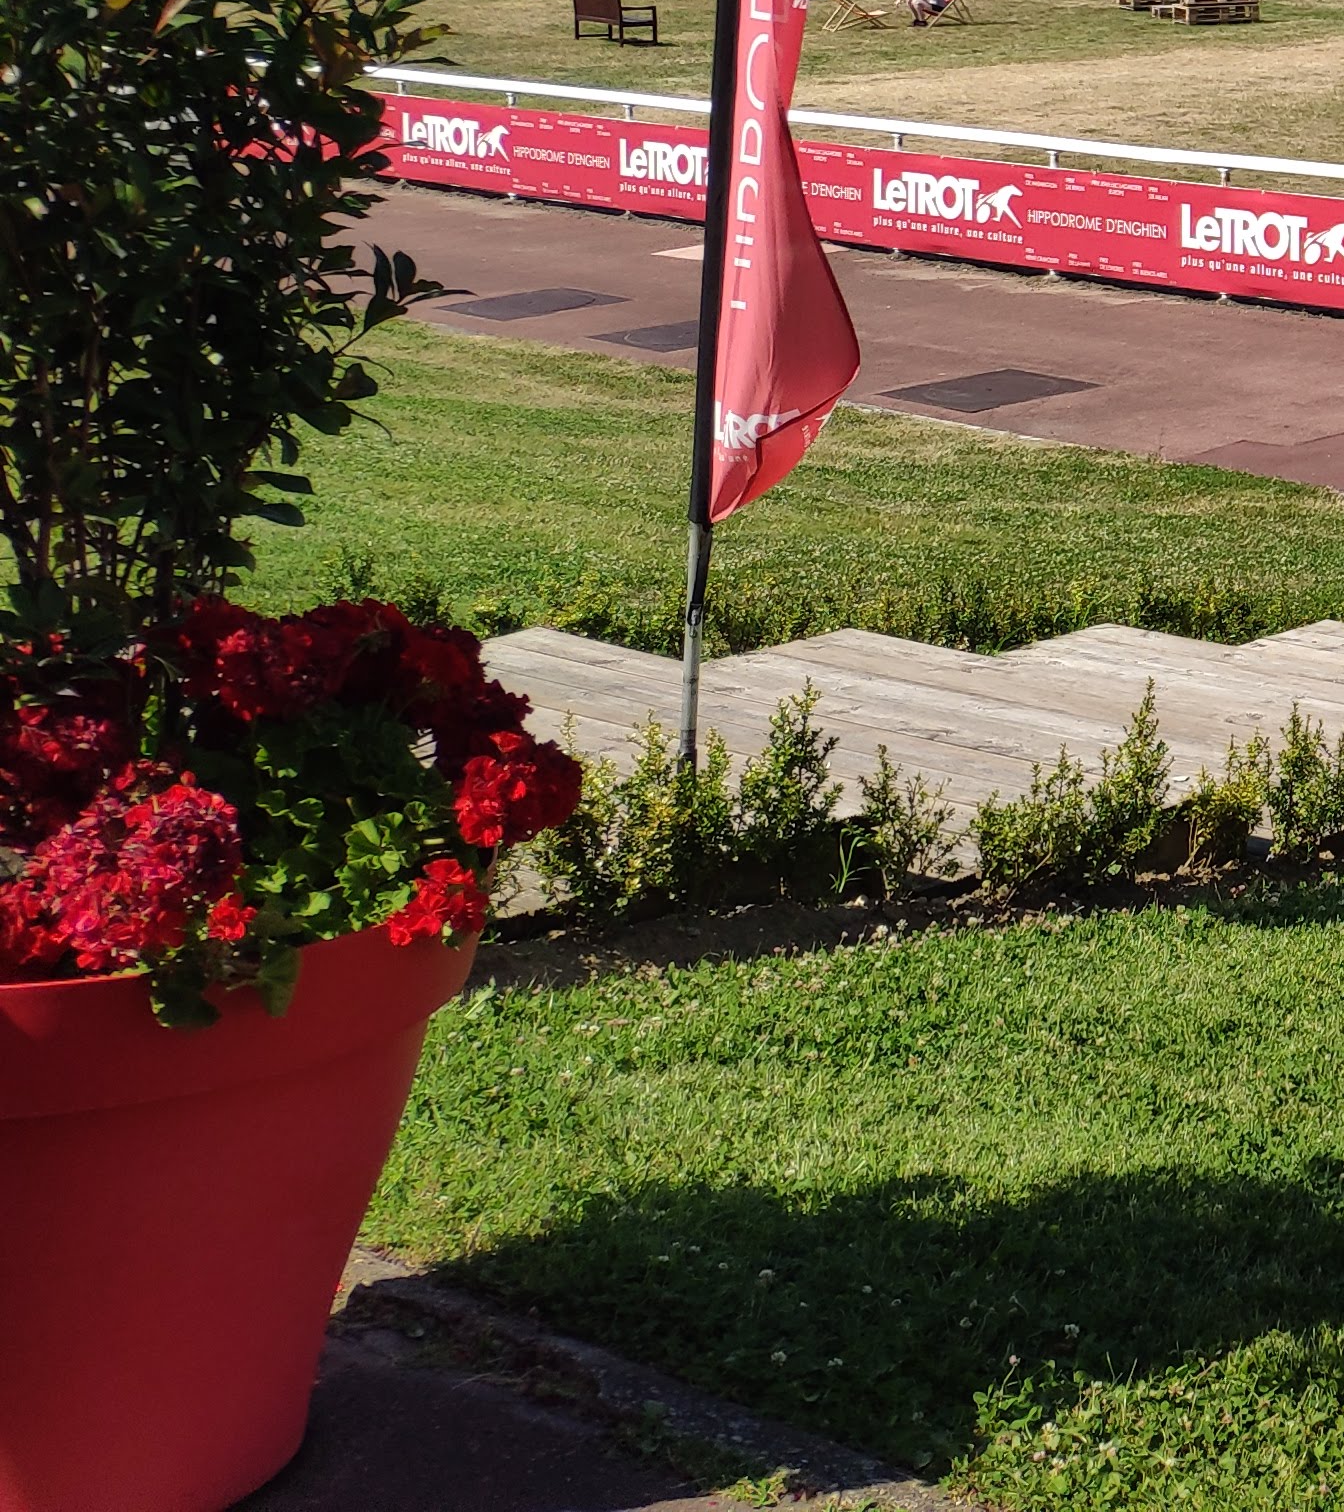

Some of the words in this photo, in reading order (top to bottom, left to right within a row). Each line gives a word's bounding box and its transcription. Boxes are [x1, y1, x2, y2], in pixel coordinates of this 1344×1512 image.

[402, 112, 479, 157] LeTROT
[513, 145, 566, 164] HIPPODROME
[567, 152, 610, 169] D'ENGHIEN
[619, 138, 708, 186] LeTROT
[811, 182, 862, 201] D'ENGHIEN
[873, 167, 980, 220] LeTROT
[873, 215, 893, 227] plus
[966, 229, 984, 239] une
[987, 231, 1023, 244] culture
[1027, 209, 1102, 231] HIPPODROME
[1105, 218, 1167, 239] D'ENGHIEN
[1181, 203, 1308, 262] LeTROT
[1180, 255, 1205, 268] plus
[1209, 258, 1245, 273] qu'une
[1292, 270, 1313, 281] une
